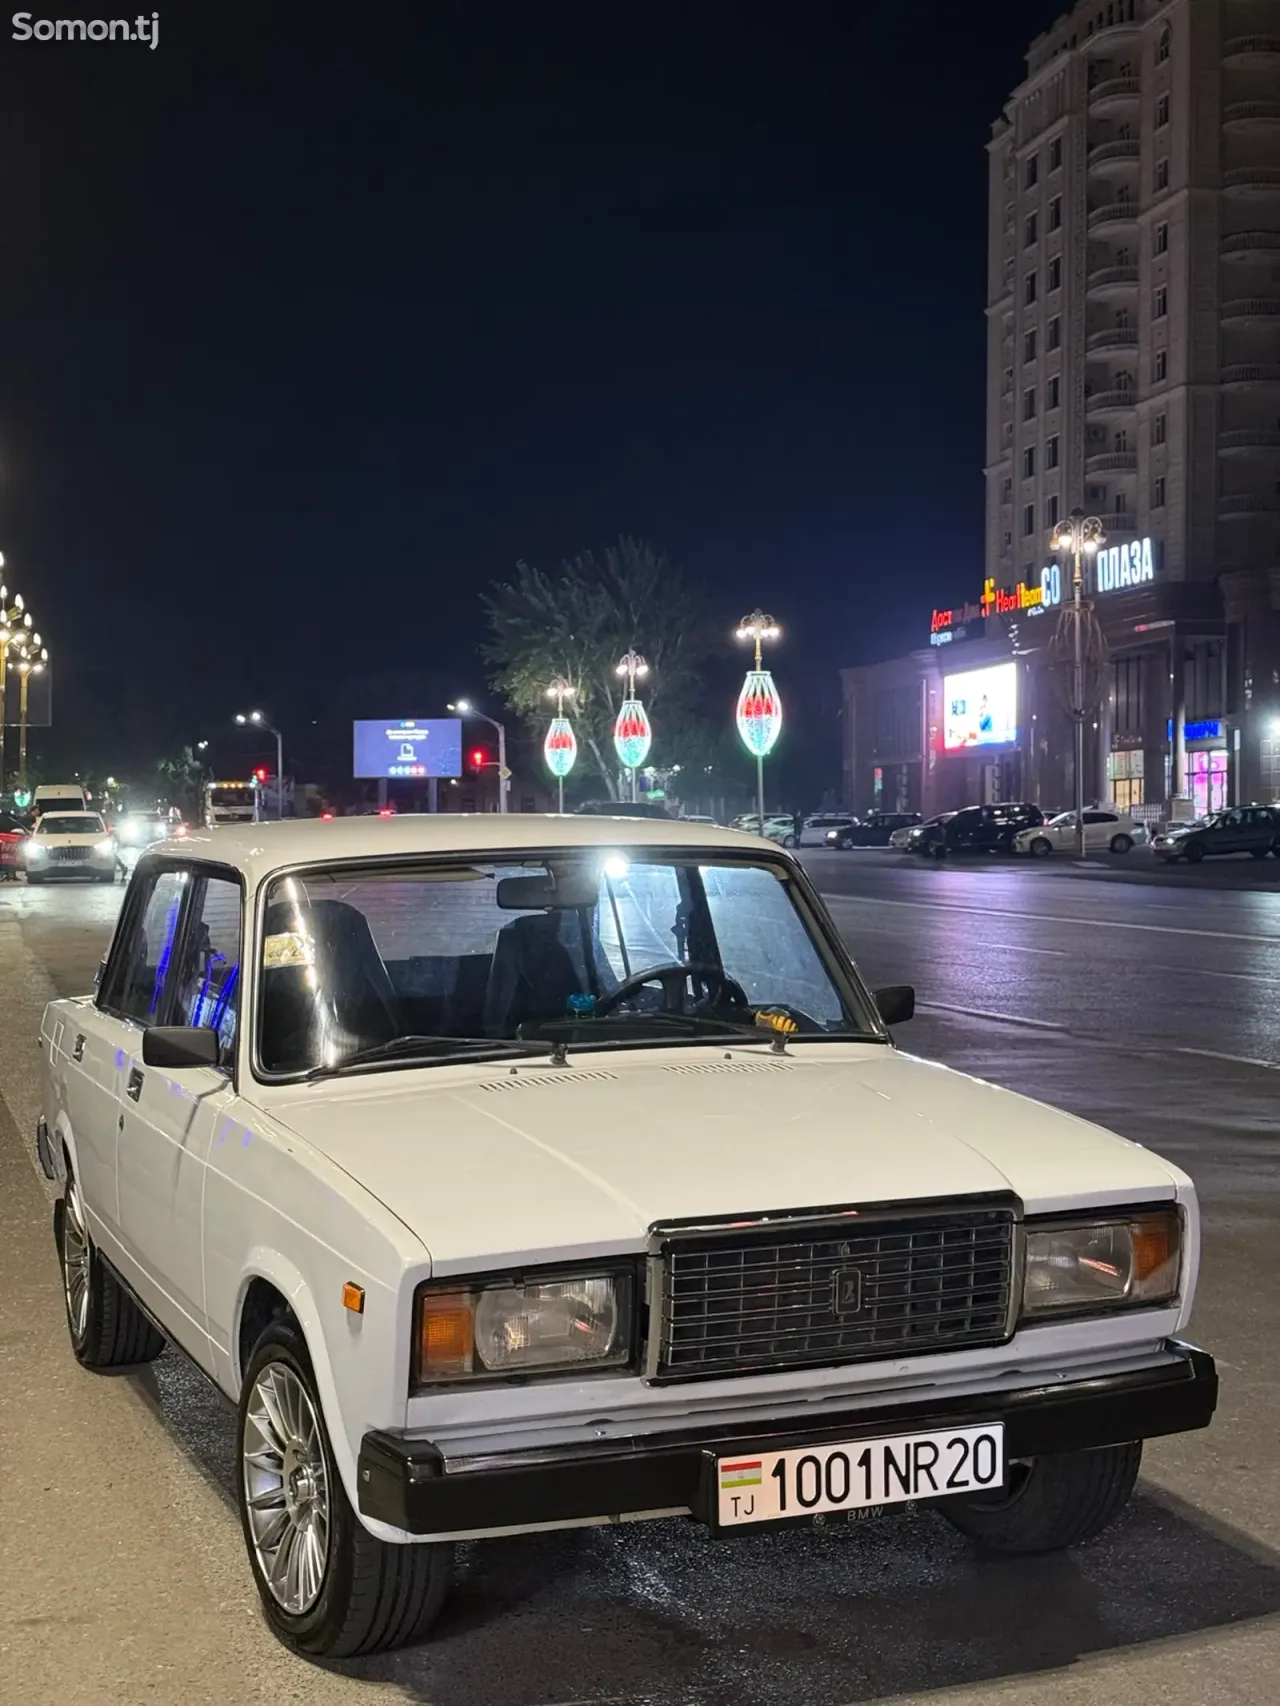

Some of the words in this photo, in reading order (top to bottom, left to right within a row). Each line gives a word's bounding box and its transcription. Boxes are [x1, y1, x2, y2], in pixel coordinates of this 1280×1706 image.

[1097, 537, 1154, 592] ПЛАЗА
[771, 1433, 997, 1511] 1001NR20
[731, 1495, 755, 1518] TJ
[847, 1506, 884, 1521] BMW
